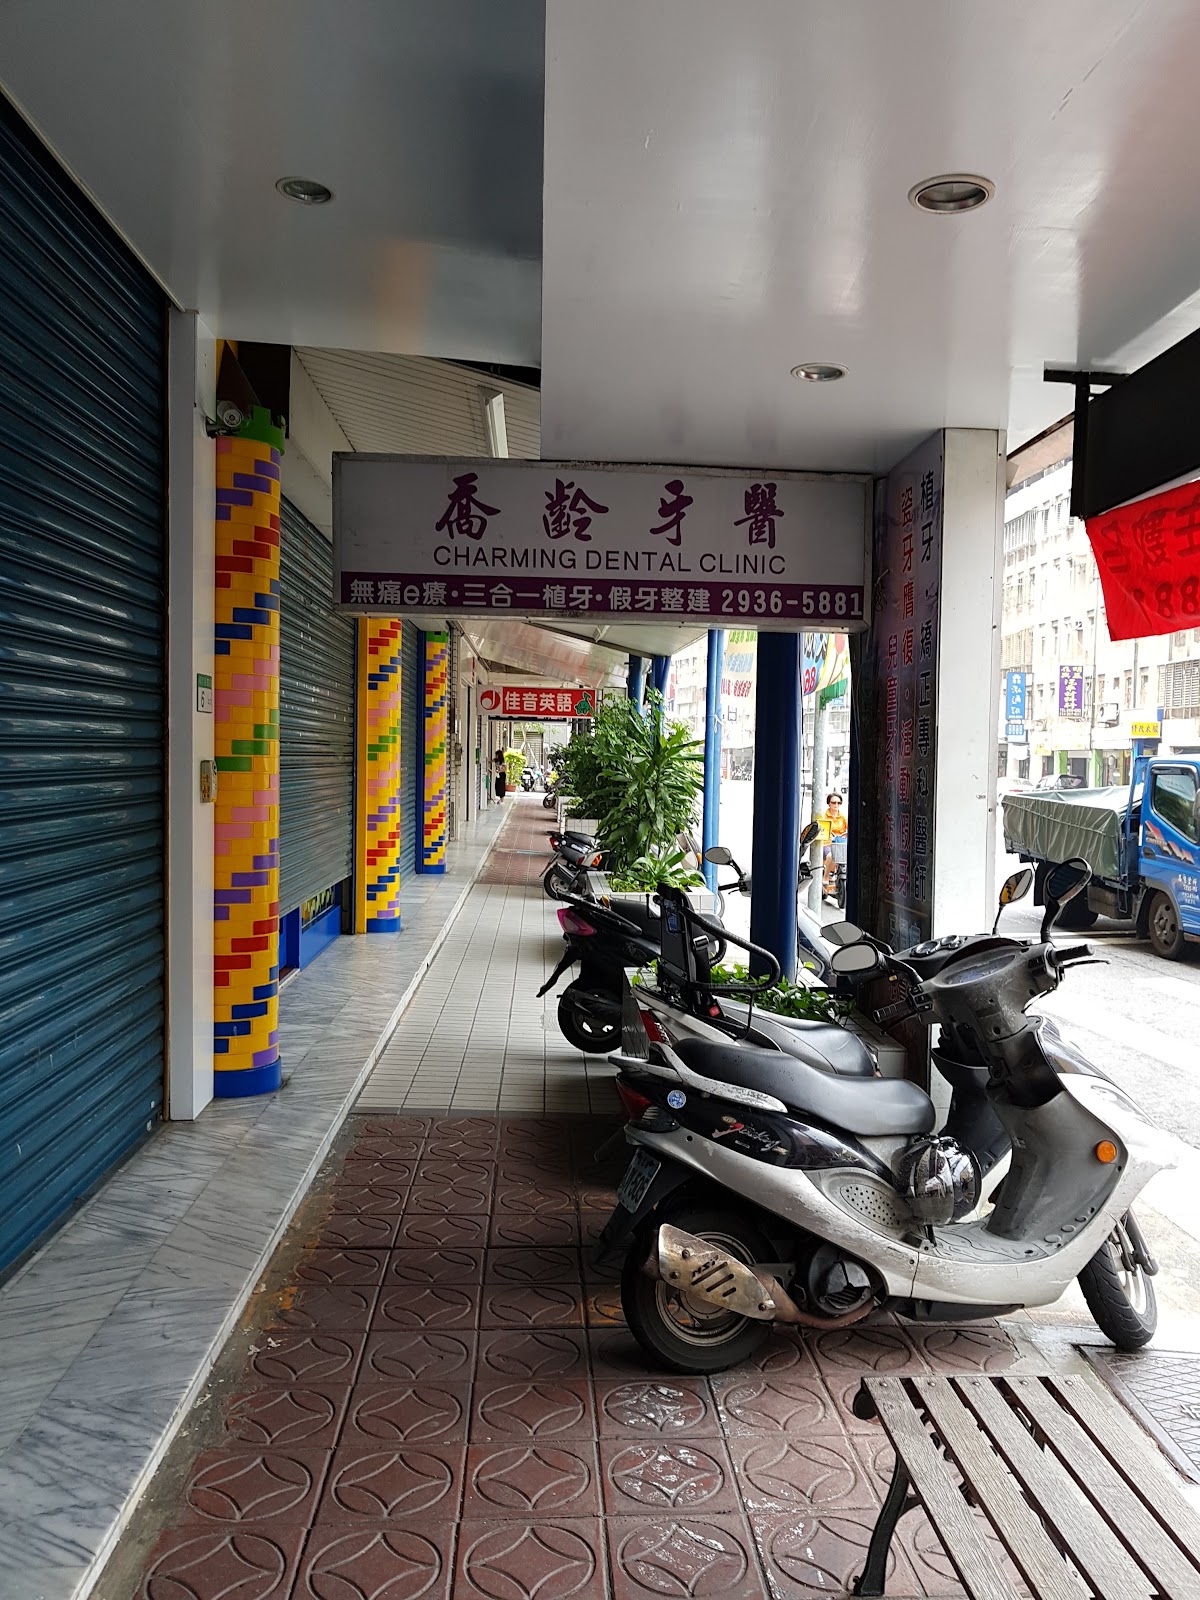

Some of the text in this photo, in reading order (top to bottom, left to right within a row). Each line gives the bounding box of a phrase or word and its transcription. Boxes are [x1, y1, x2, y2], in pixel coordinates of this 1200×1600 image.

[435, 472, 785, 549] 喬齡牙醫
[433, 545, 786, 575] CHARMING DENTAL CLINIC
[721, 588, 863, 616] 2936-5881
[504, 690, 572, 713] 佳音英語
